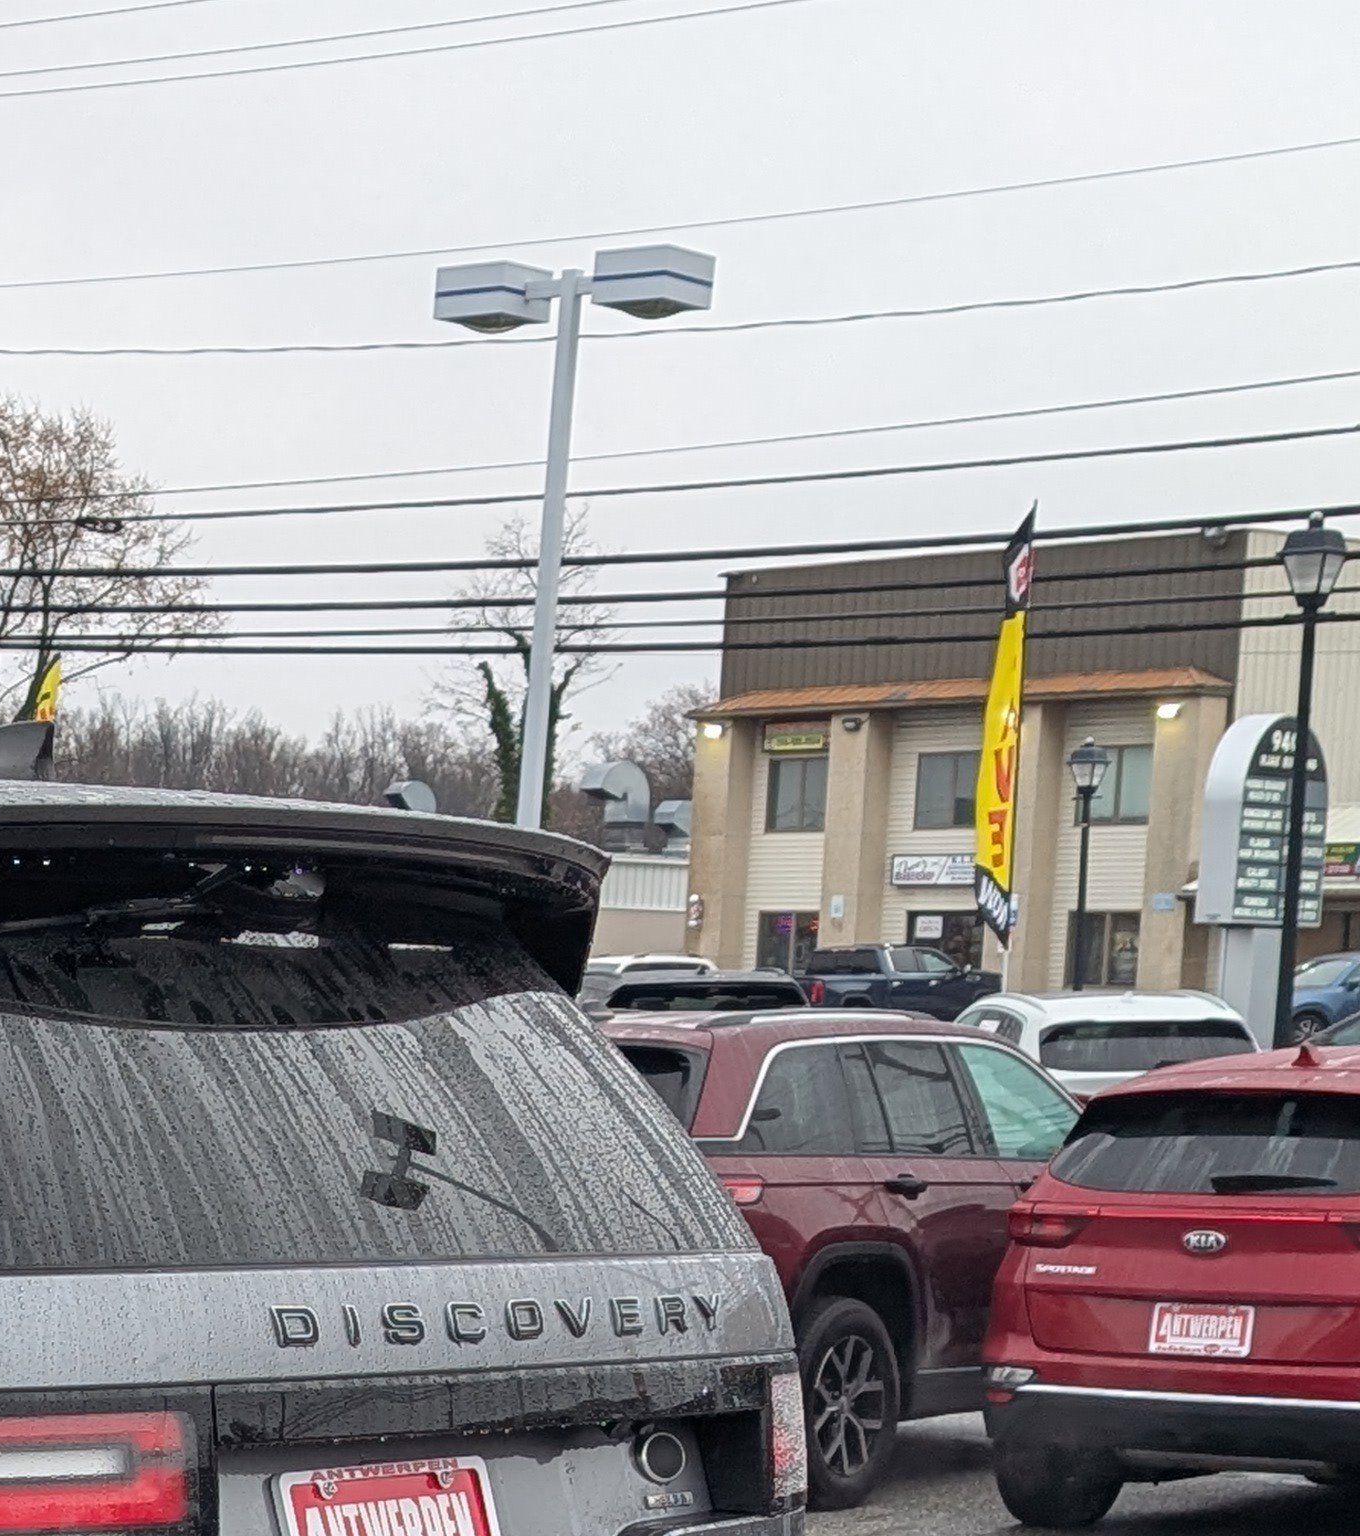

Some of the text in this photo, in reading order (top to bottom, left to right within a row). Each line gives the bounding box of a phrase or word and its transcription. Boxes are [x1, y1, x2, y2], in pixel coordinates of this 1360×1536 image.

[271, 1294, 721, 1347] DISCOVERY
[1158, 1312, 1244, 1340] ANTWERPEN
[310, 1457, 460, 1482] ANTWERPEN
